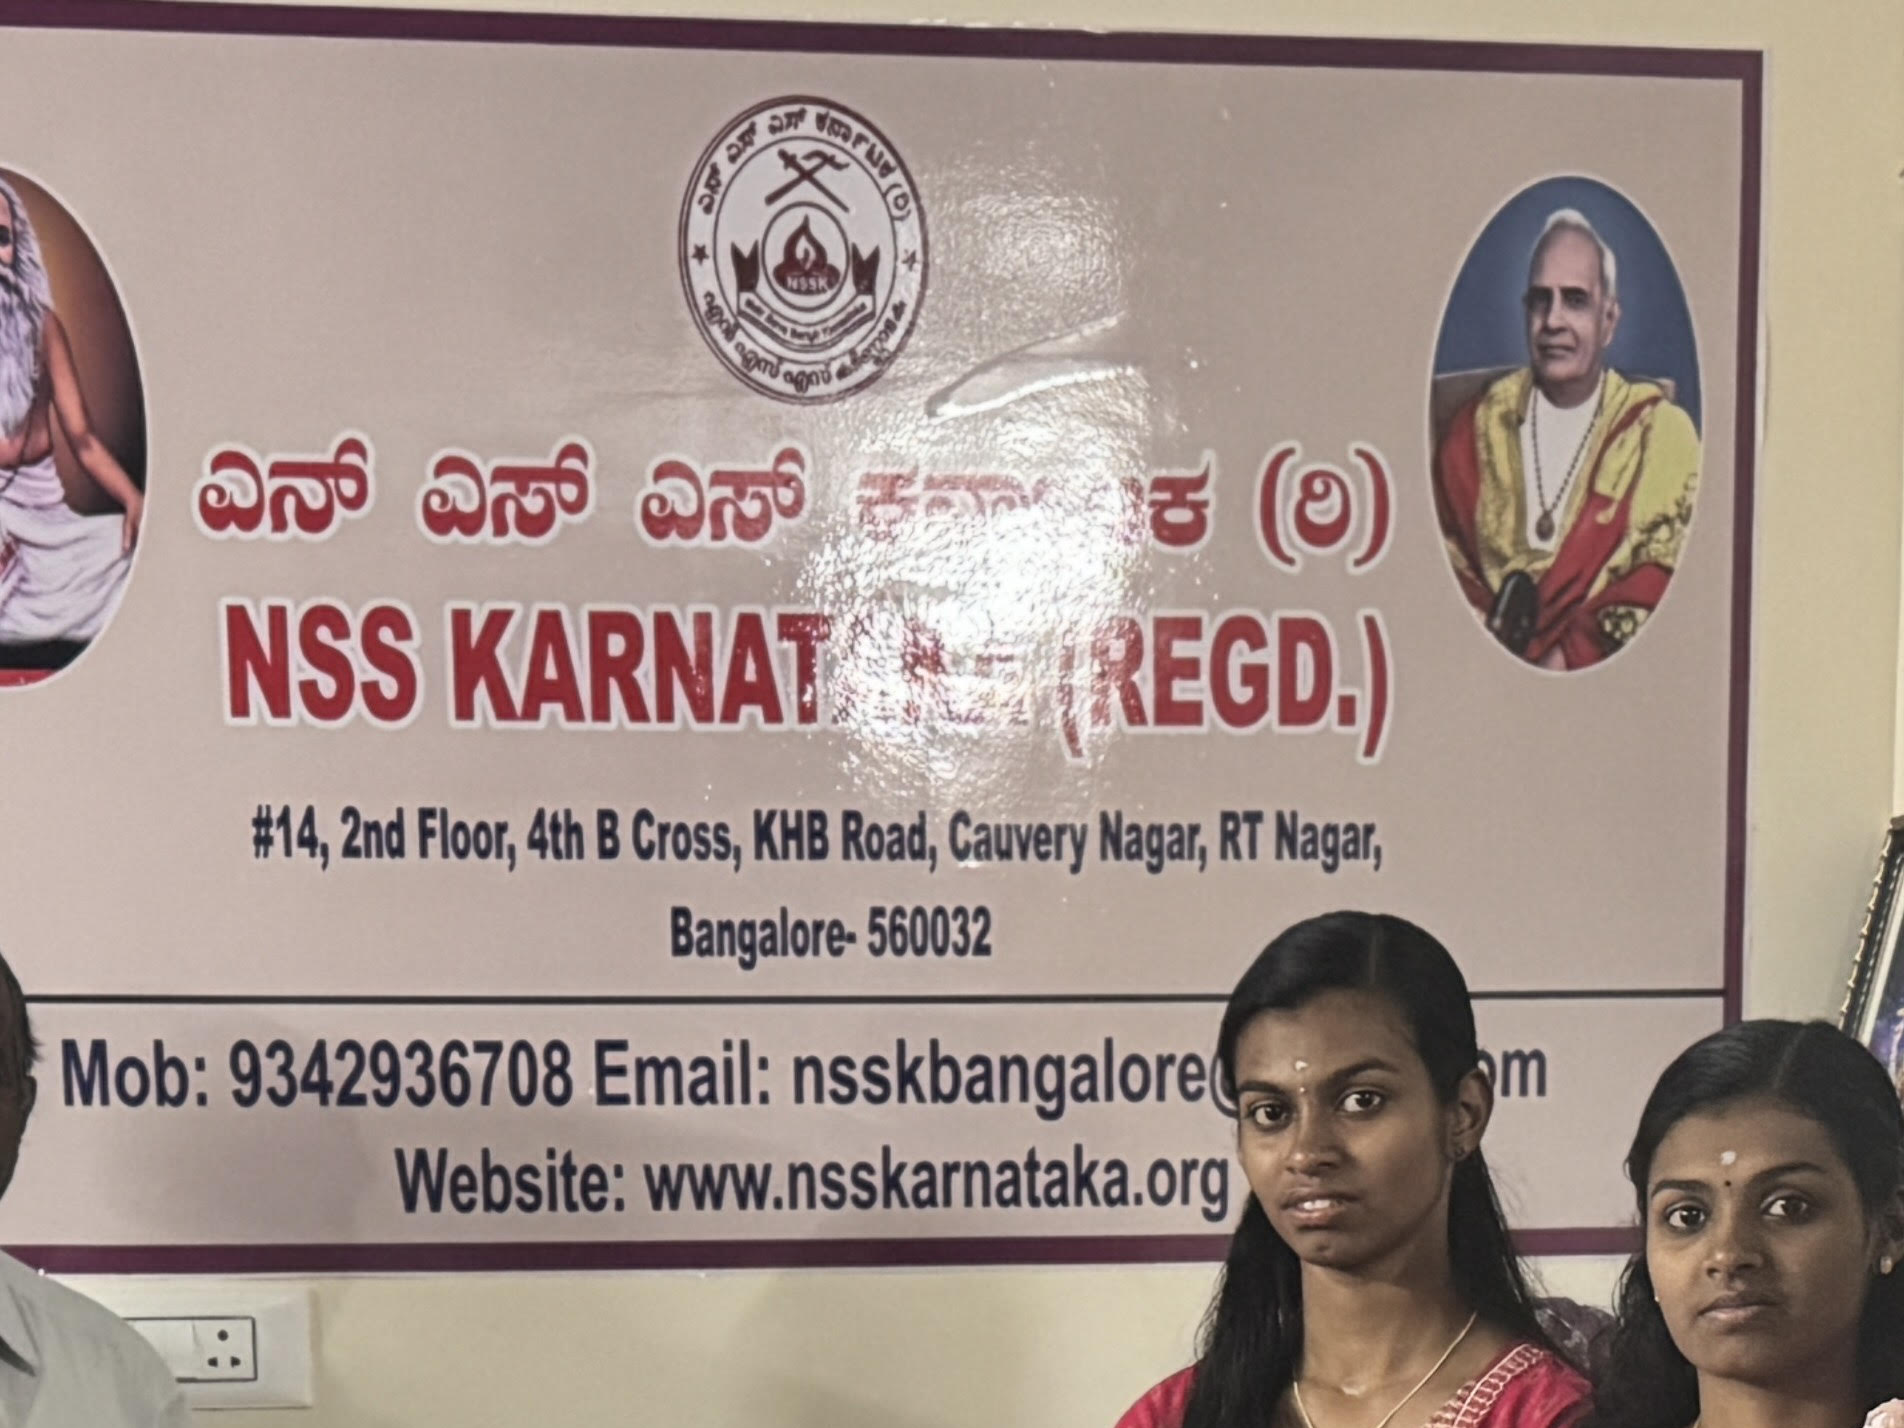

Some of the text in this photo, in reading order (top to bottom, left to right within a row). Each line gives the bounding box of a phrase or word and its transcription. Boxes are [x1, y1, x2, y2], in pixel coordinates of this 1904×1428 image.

[199, 439, 368, 533] ಎನ್
[423, 444, 587, 537] ಎಸ್
[644, 450, 801, 540] ಎಸ್
[1260, 447, 1389, 567] (ರಿ)
[227, 605, 416, 721] NSS
[1058, 613, 1388, 758] (REGD.)
[252, 805, 1382, 875] #14, 2nd Floor, 4th B Cross, KHB Road, Cauvery Nagar, RT Nagar,
[670, 905, 992, 971] Bangalore- 560032
[61, 1038, 208, 1108] Mob:
[229, 1038, 573, 1108] 9342936708
[594, 1039, 770, 1106] Email:
[394, 1143, 1228, 1223] Website: www.nsskarnataka.org
